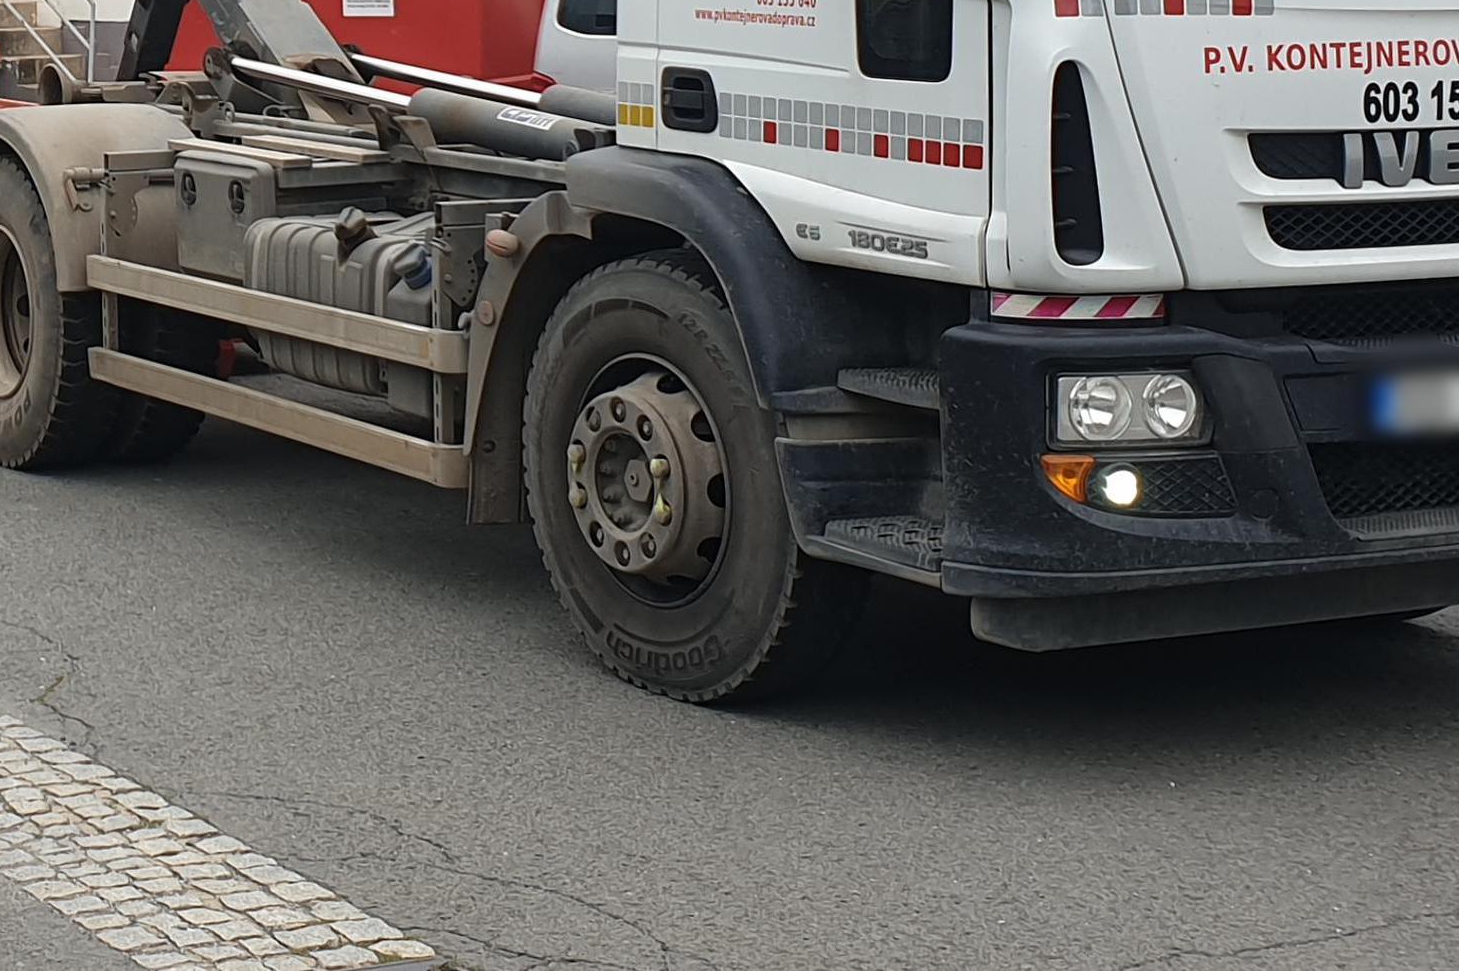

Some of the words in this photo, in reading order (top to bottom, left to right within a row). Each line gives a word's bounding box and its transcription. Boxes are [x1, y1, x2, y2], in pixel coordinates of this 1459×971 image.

[695, 8, 816, 27] www.pvkontejnerovadoprava.cz
[1204, 46, 1253, 74] P.V.
[1363, 81, 1420, 123] 603
[848, 229, 928, 259] 180E25
